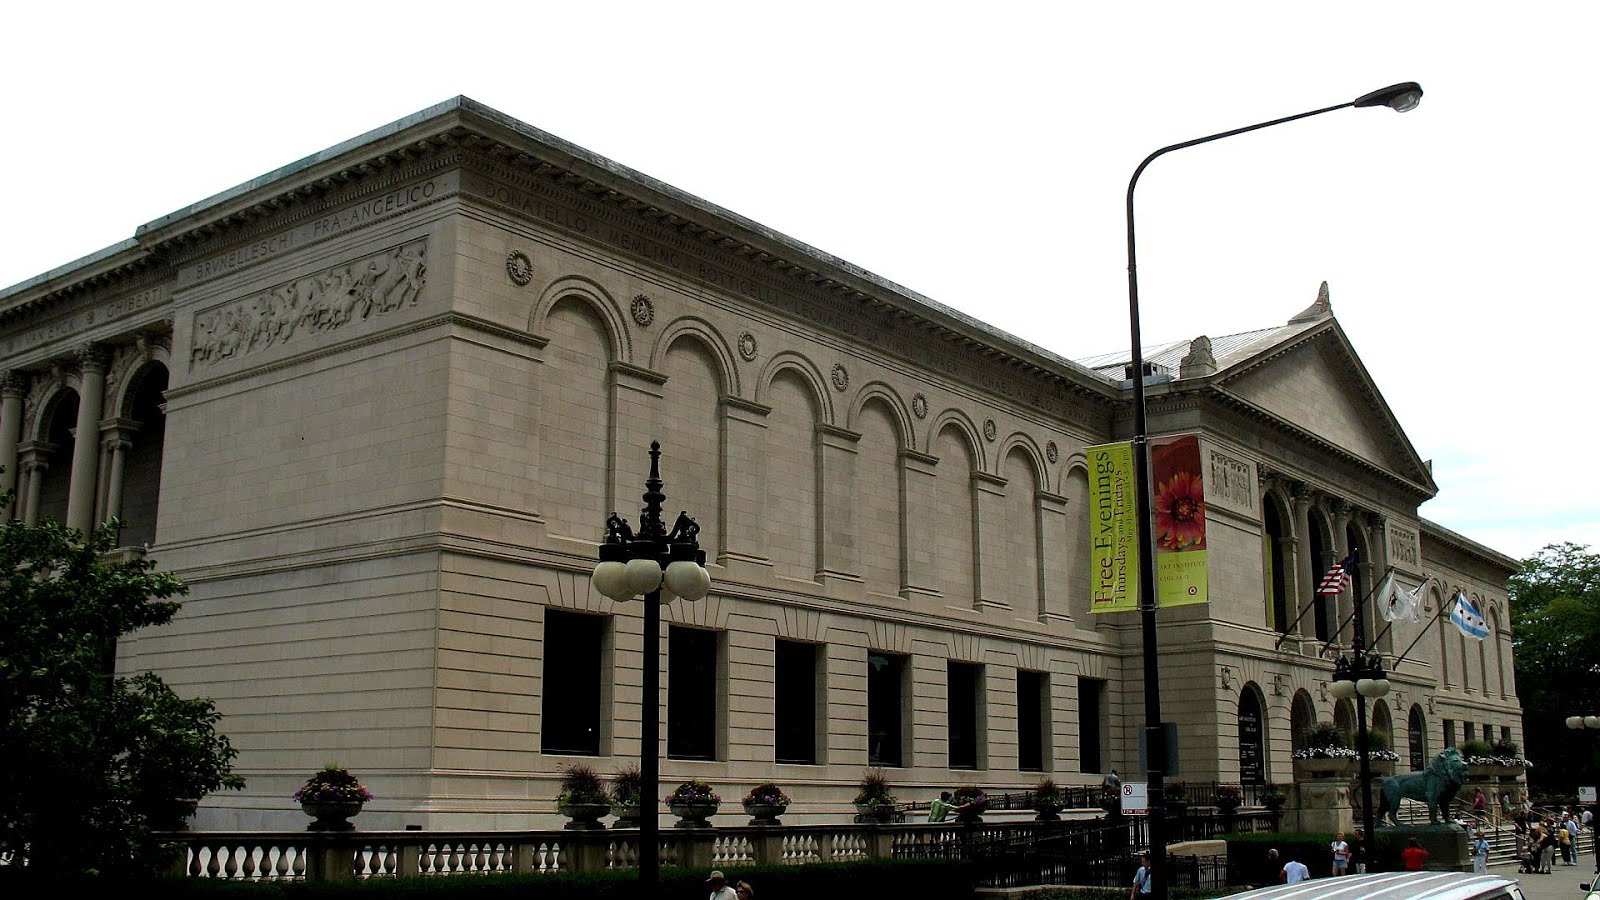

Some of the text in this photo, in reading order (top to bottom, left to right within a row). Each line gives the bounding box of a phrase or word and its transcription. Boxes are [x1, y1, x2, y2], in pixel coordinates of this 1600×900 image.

[486, 182, 586, 232] DONATELLO
[1092, 452, 1115, 604] Free Evenings
[1113, 470, 1128, 604] Thursdays and Fridays
